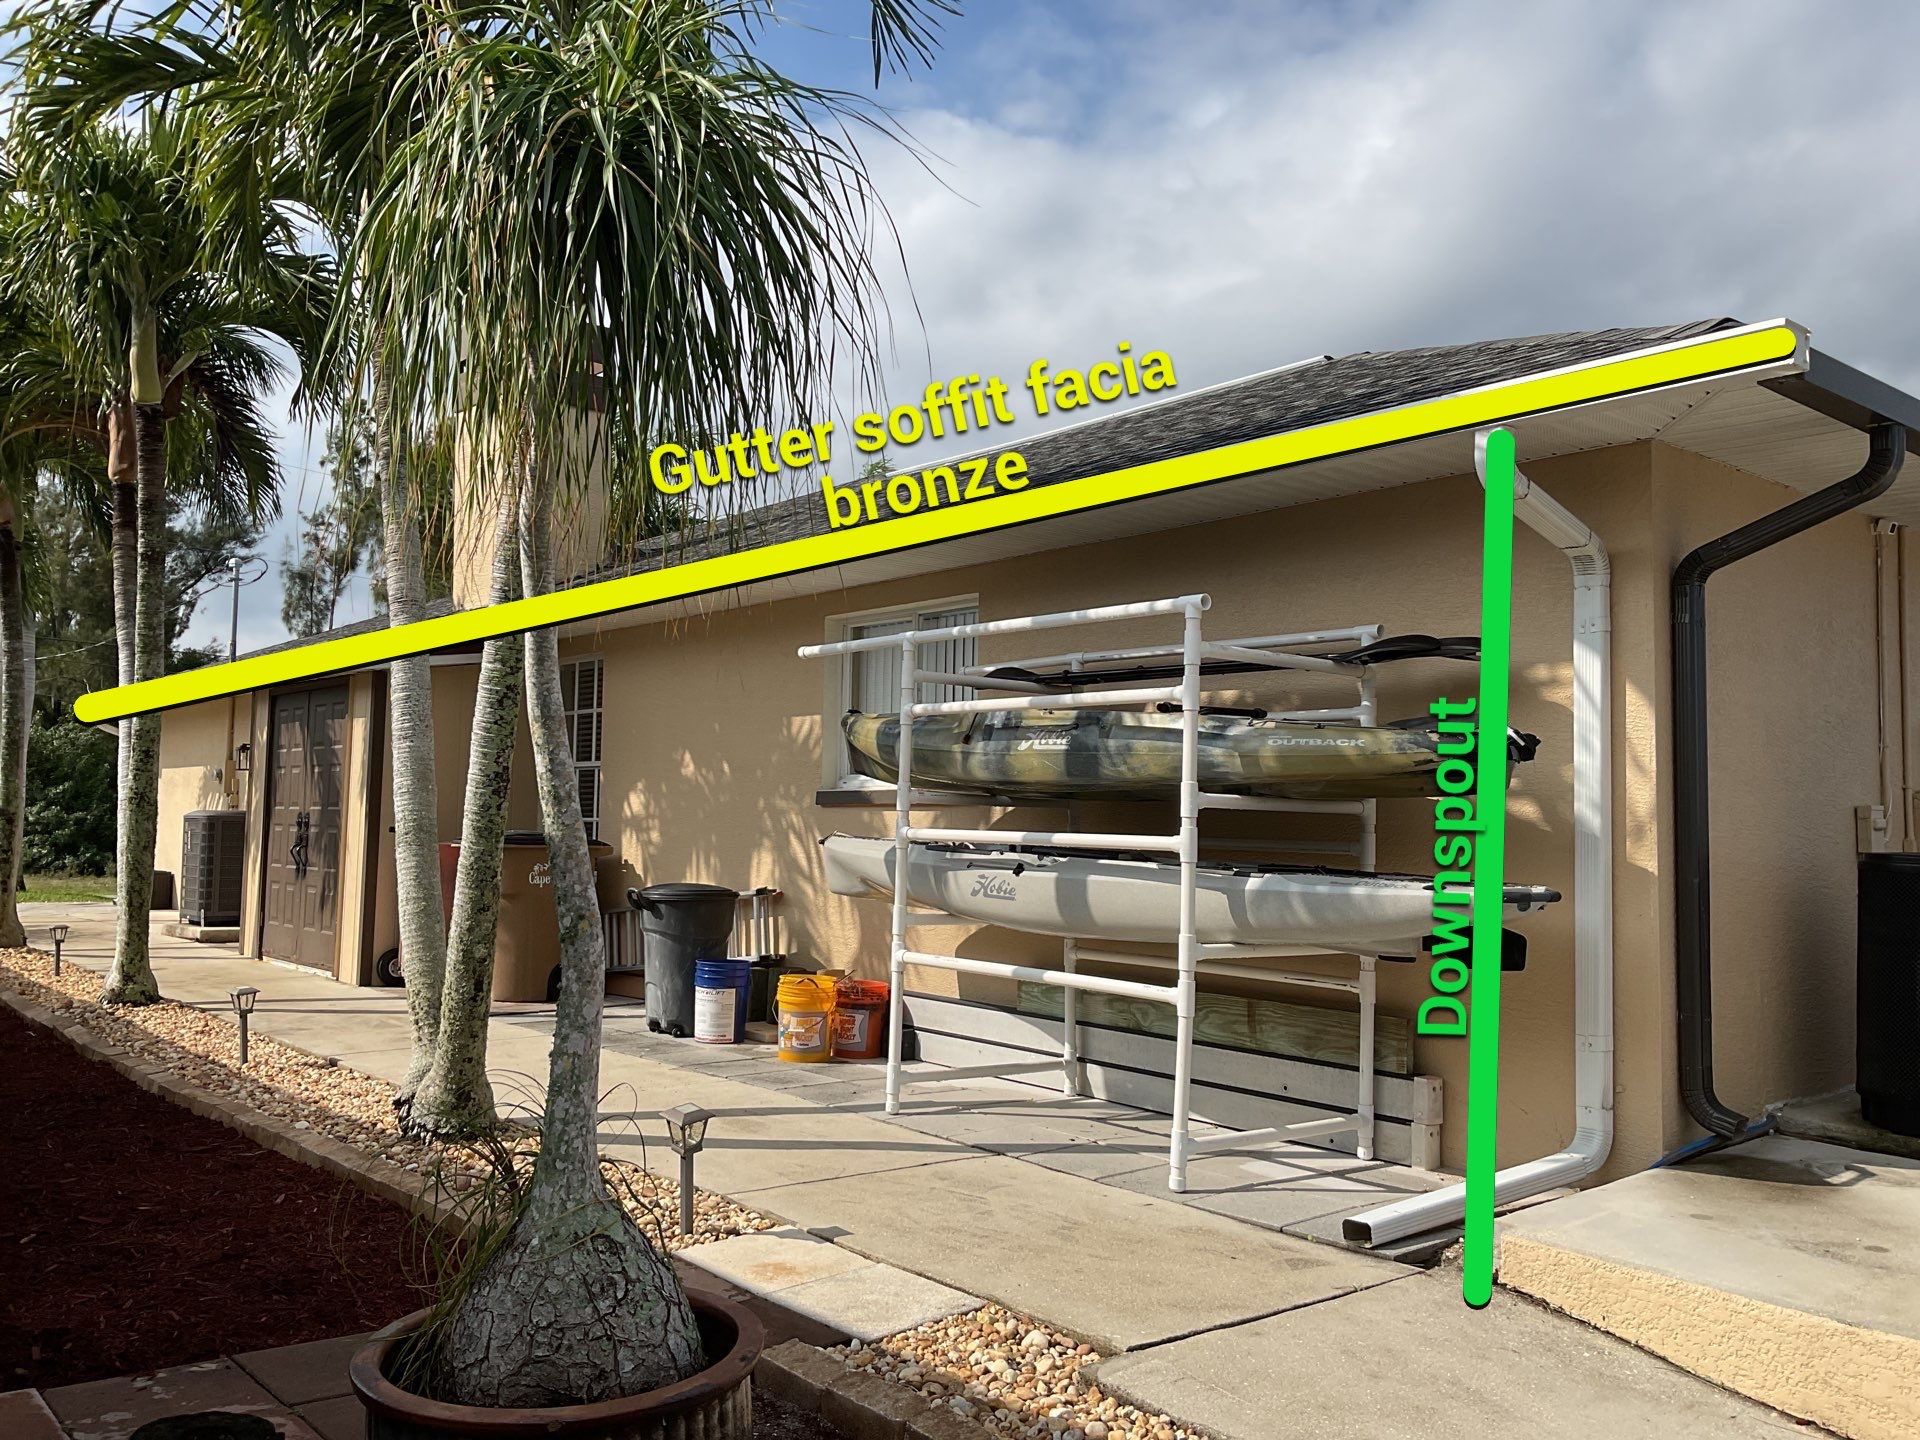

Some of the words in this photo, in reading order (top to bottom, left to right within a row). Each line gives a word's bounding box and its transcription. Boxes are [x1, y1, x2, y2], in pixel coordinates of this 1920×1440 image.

[1017, 729, 1072, 751] Hobie
[1267, 738, 1366, 747] OUTBACK
[528, 871, 552, 888] Cape
[970, 873, 1017, 901] Hobie
